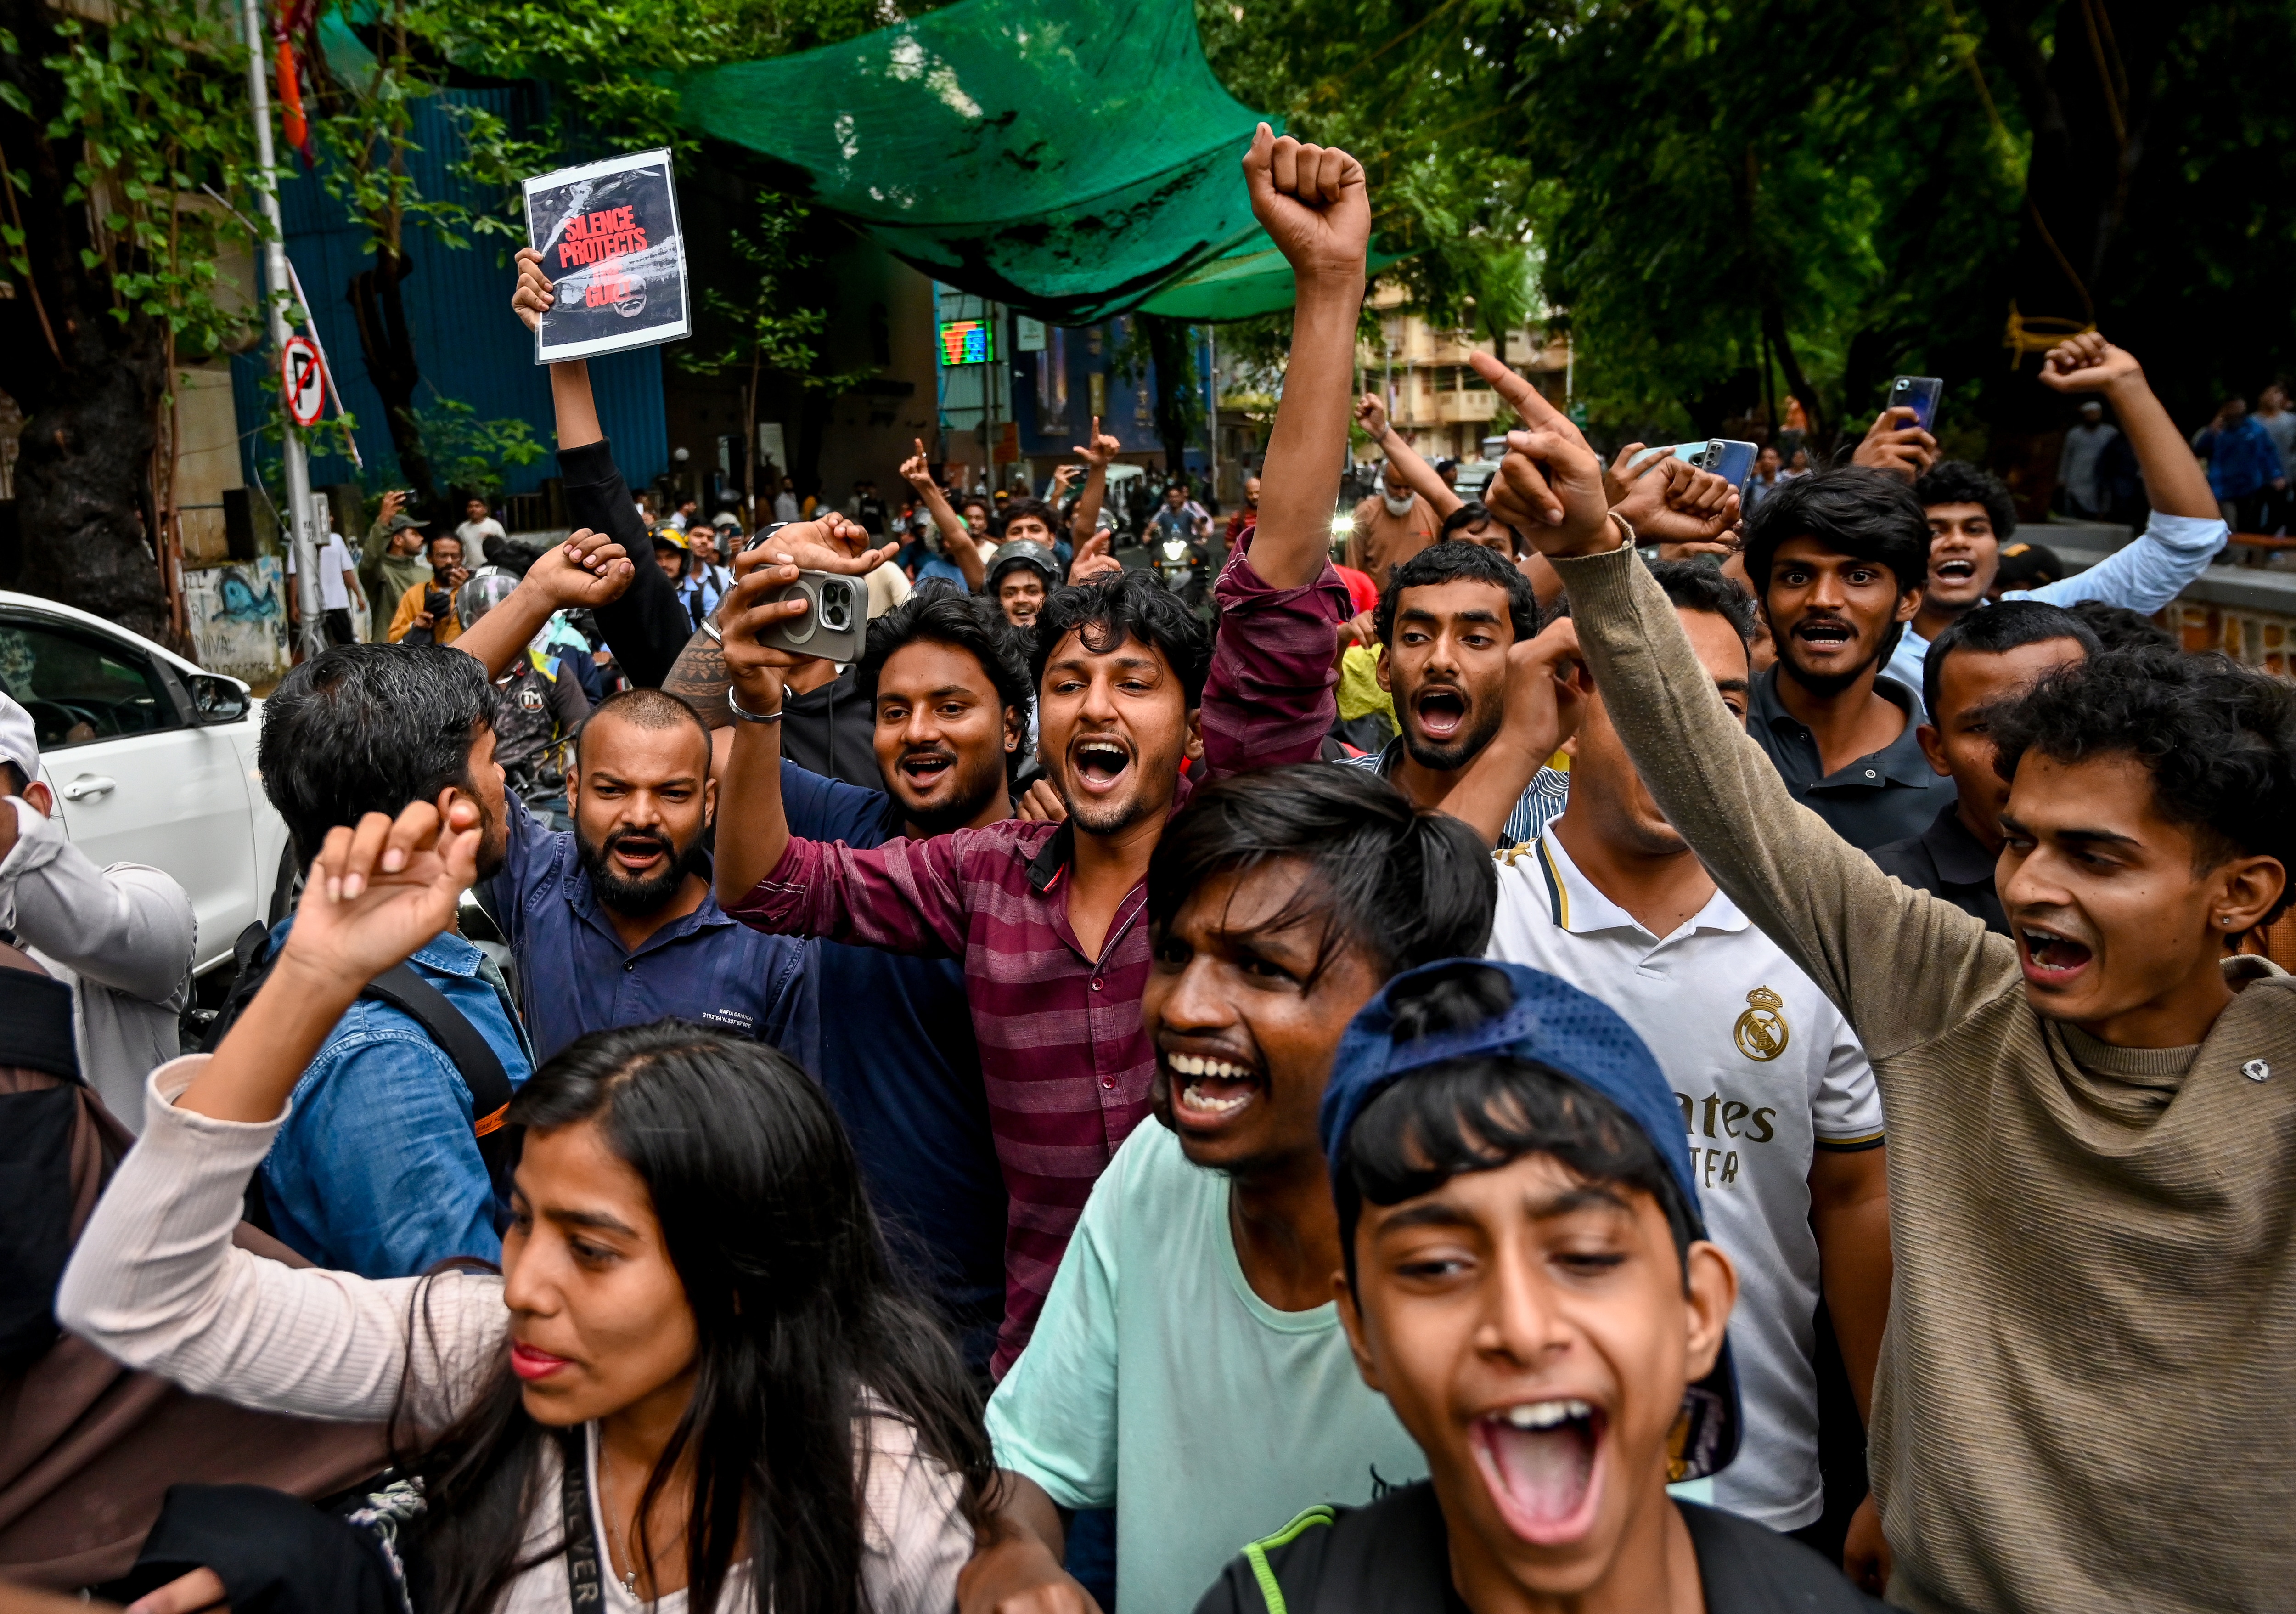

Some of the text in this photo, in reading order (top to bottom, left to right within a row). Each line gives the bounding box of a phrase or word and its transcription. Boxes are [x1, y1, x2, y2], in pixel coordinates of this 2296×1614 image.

[564, 205, 636, 242] SILENCE
[558, 227, 648, 268] PROTECTS
[589, 257, 624, 284] THE
[585, 279, 632, 308] GUILT
[734, 1012, 754, 1022] ORIGINAL
